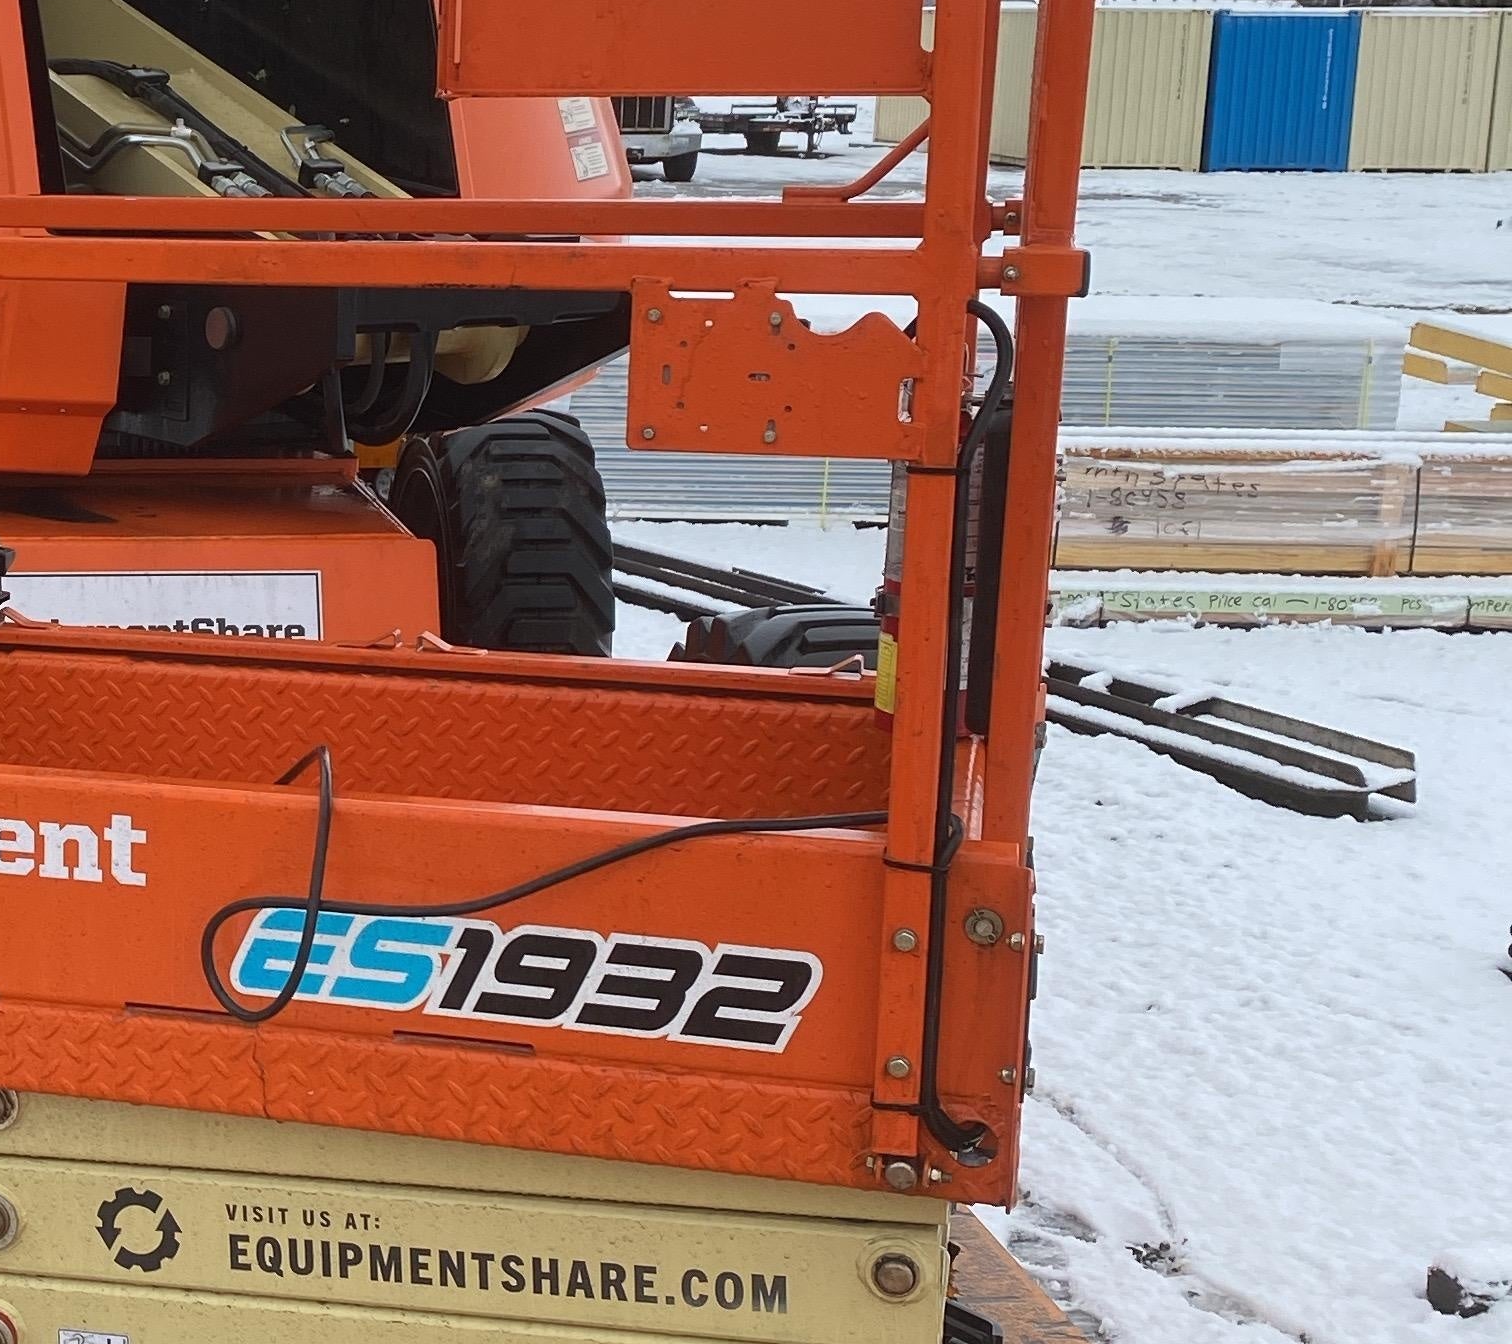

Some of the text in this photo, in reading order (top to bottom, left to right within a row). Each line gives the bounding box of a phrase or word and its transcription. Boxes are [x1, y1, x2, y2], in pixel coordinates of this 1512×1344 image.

[234, 909, 820, 1050] ES1932
[225, 1202, 382, 1231] VISIT US AT:
[227, 1231, 790, 1315] EQUIPMENTSHARE.COM
